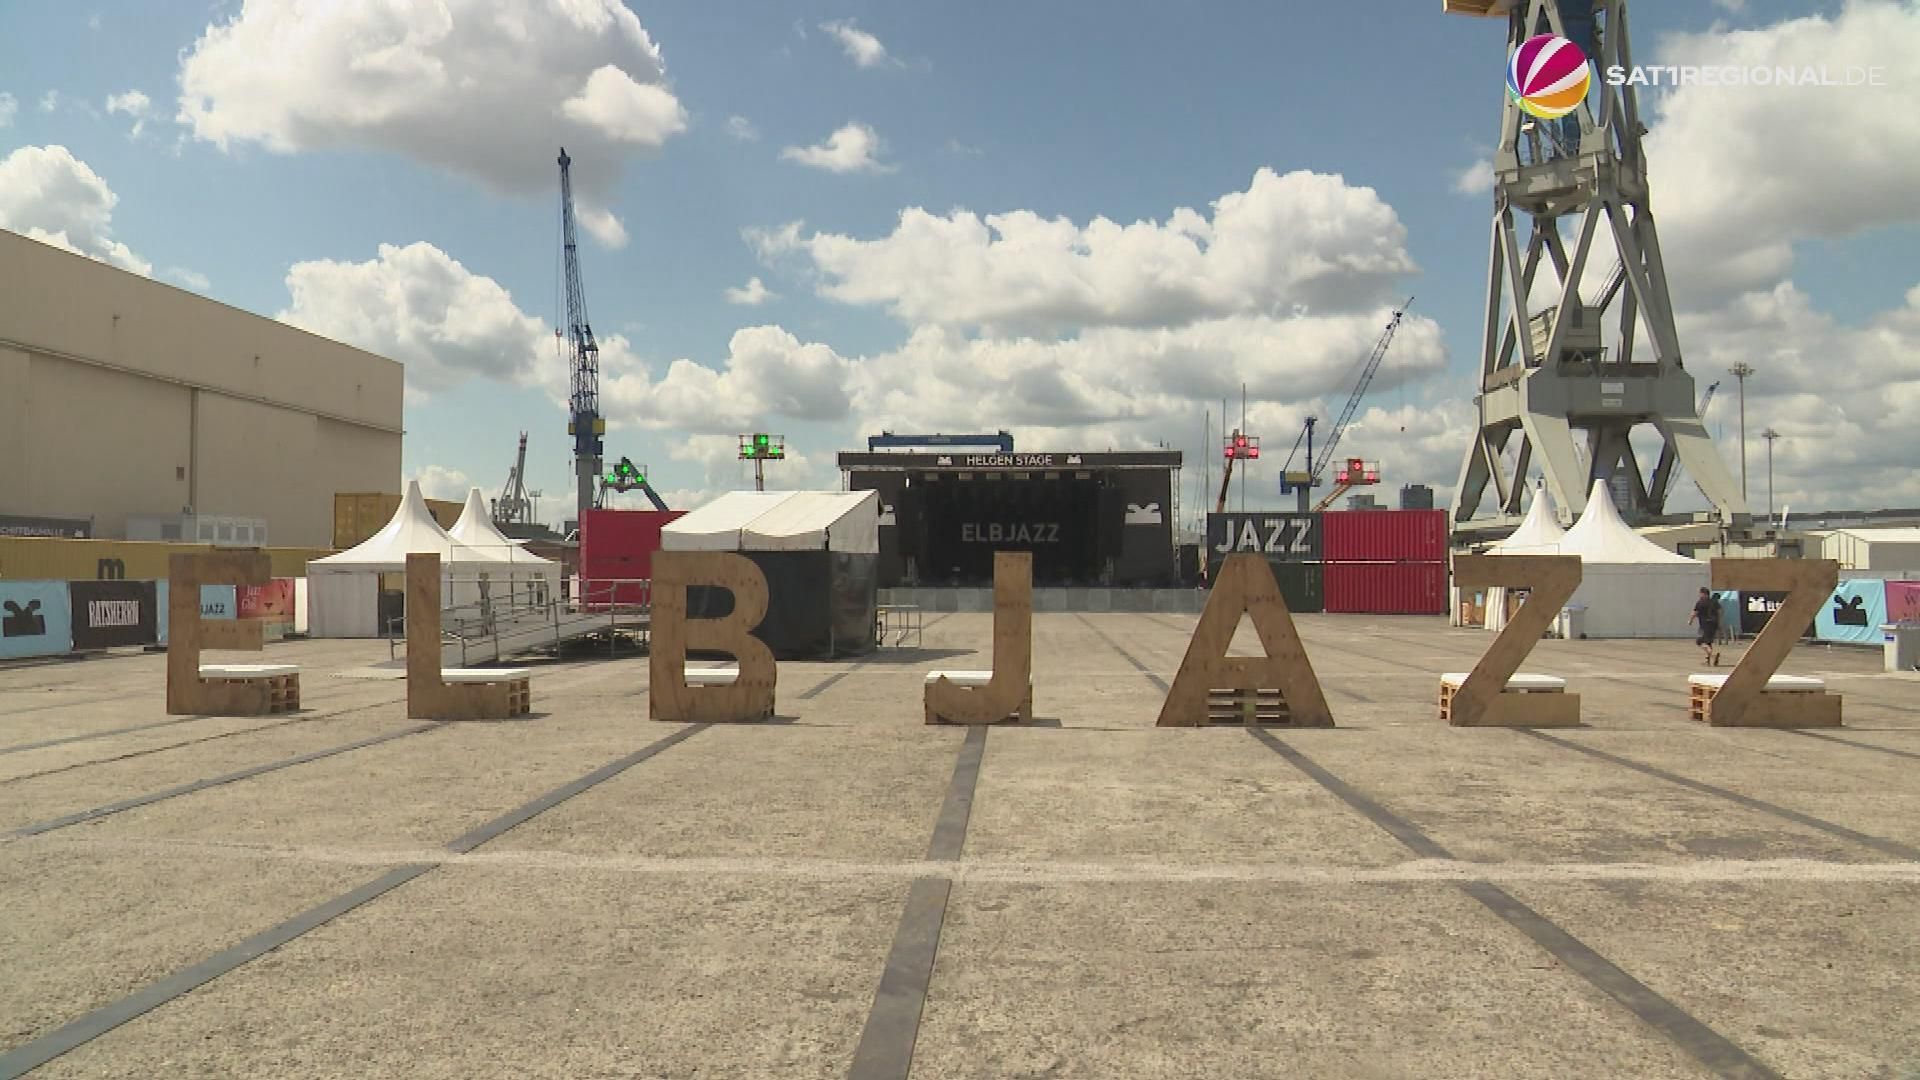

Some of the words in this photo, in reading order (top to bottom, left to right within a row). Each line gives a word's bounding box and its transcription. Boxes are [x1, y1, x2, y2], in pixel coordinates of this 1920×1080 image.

[966, 455, 1013, 467] HELGEN
[1016, 455, 1052, 466] STAGE
[961, 523, 1060, 543] ELBJAZZ
[1215, 518, 1312, 553] JAZZ
[88, 600, 139, 627] RATSHERRN
